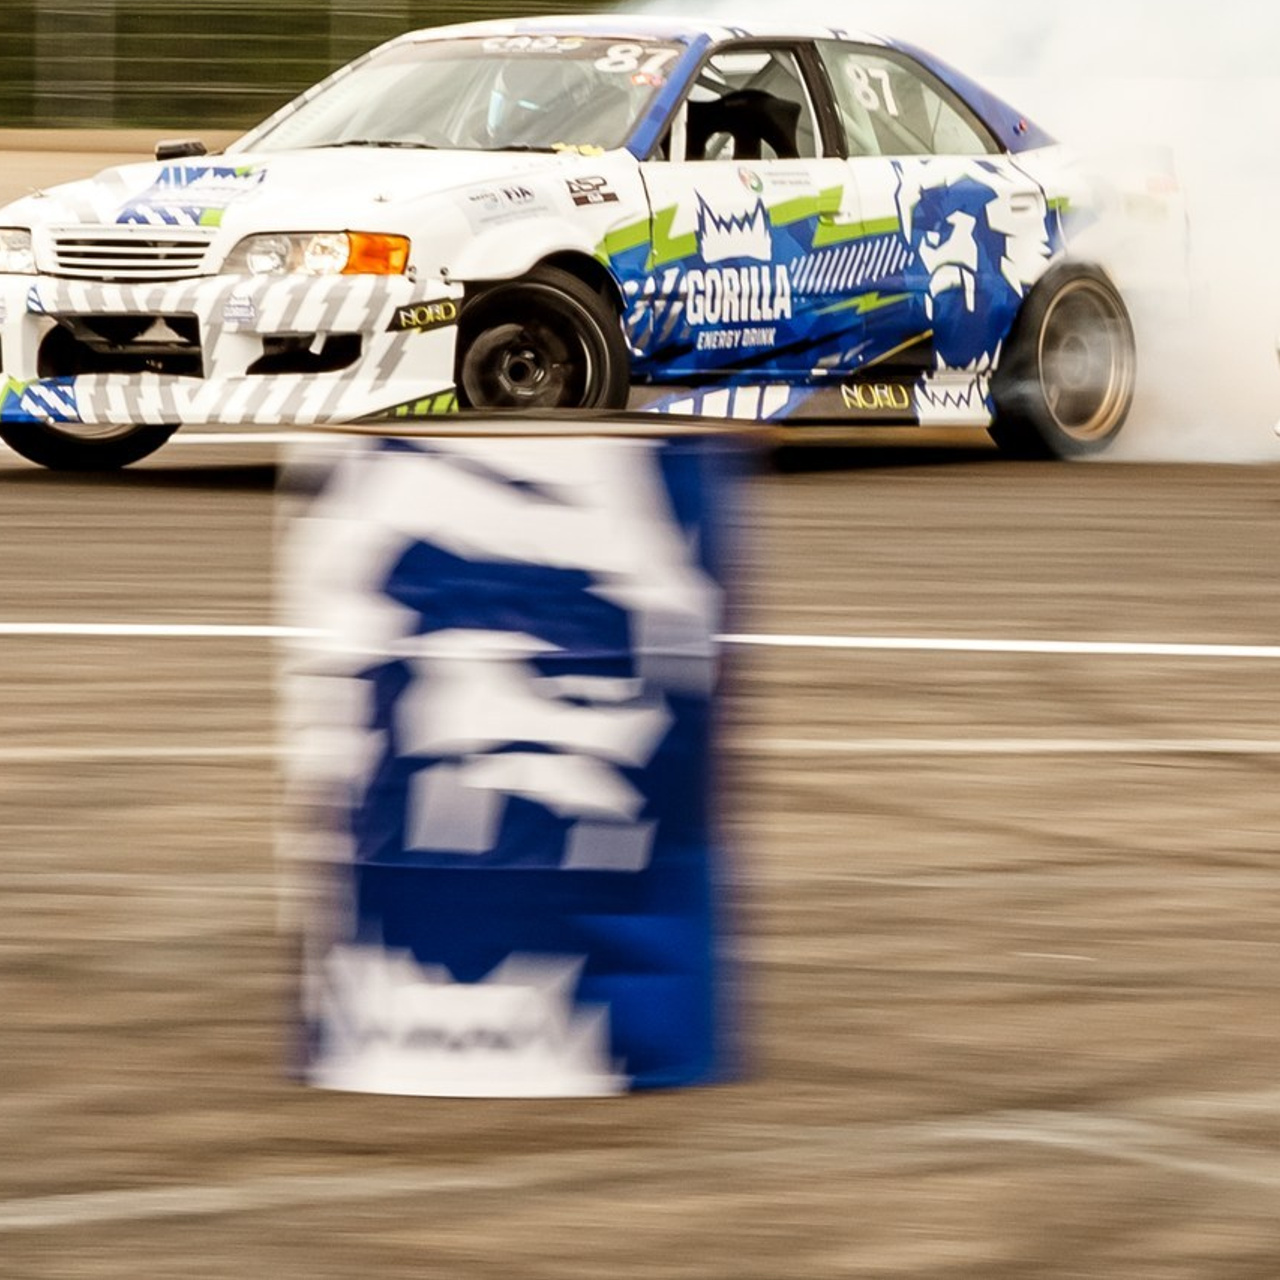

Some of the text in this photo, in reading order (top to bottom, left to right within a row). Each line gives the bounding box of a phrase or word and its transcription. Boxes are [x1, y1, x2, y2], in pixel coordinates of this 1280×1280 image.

[594, 43, 679, 73] 87
[845, 62, 898, 116] 87
[686, 264, 792, 325] GORILLA
[400, 302, 453, 327] NORD
[697, 327, 776, 350] ENERGY DRINK
[841, 383, 909, 410] NORD
